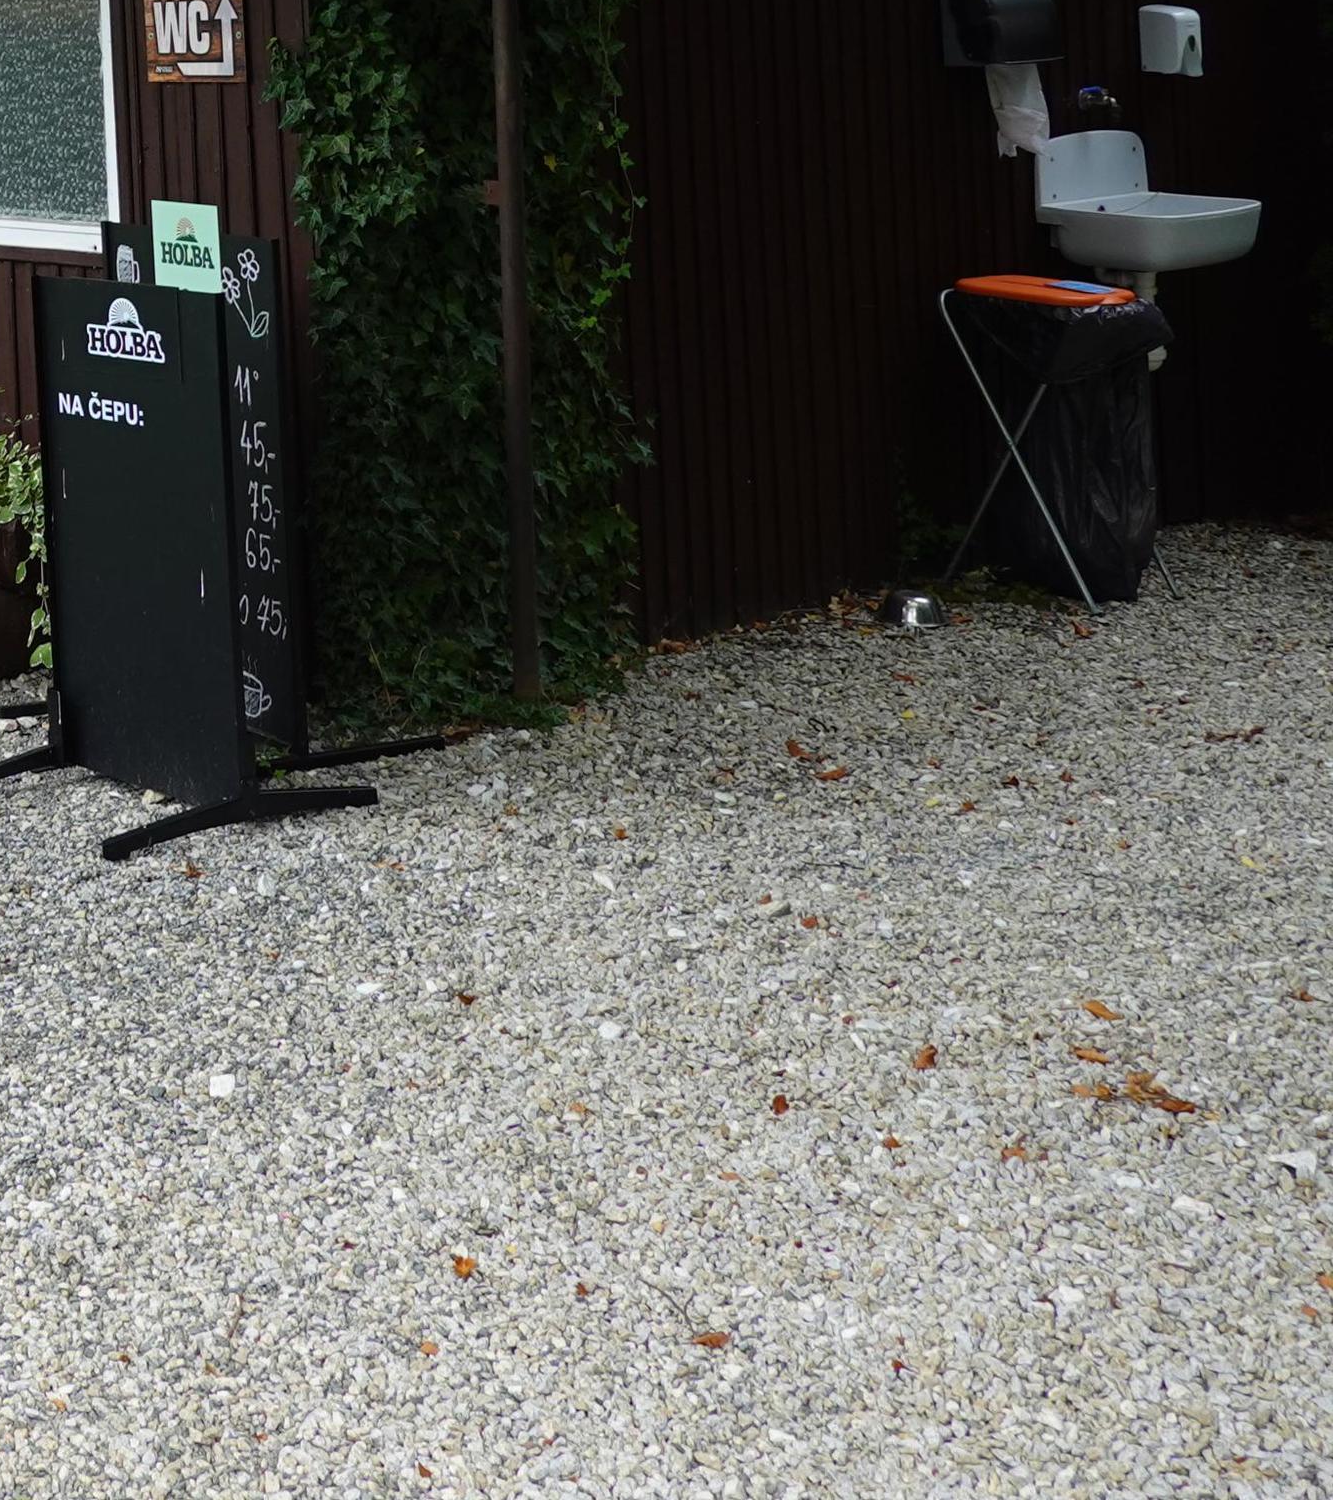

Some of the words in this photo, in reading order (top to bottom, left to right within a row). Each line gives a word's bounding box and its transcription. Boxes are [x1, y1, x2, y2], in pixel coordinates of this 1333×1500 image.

[153, 0, 211, 54] WC
[160, 241, 215, 269] HOLBA
[87, 324, 165, 363] HOLBA
[58, 392, 84, 417] NA
[88, 391, 144, 426] ČEPU:
[240, 420, 276, 474] 45,-
[248, 480, 281, 529] 75,-
[245, 527, 281, 573] 65,-
